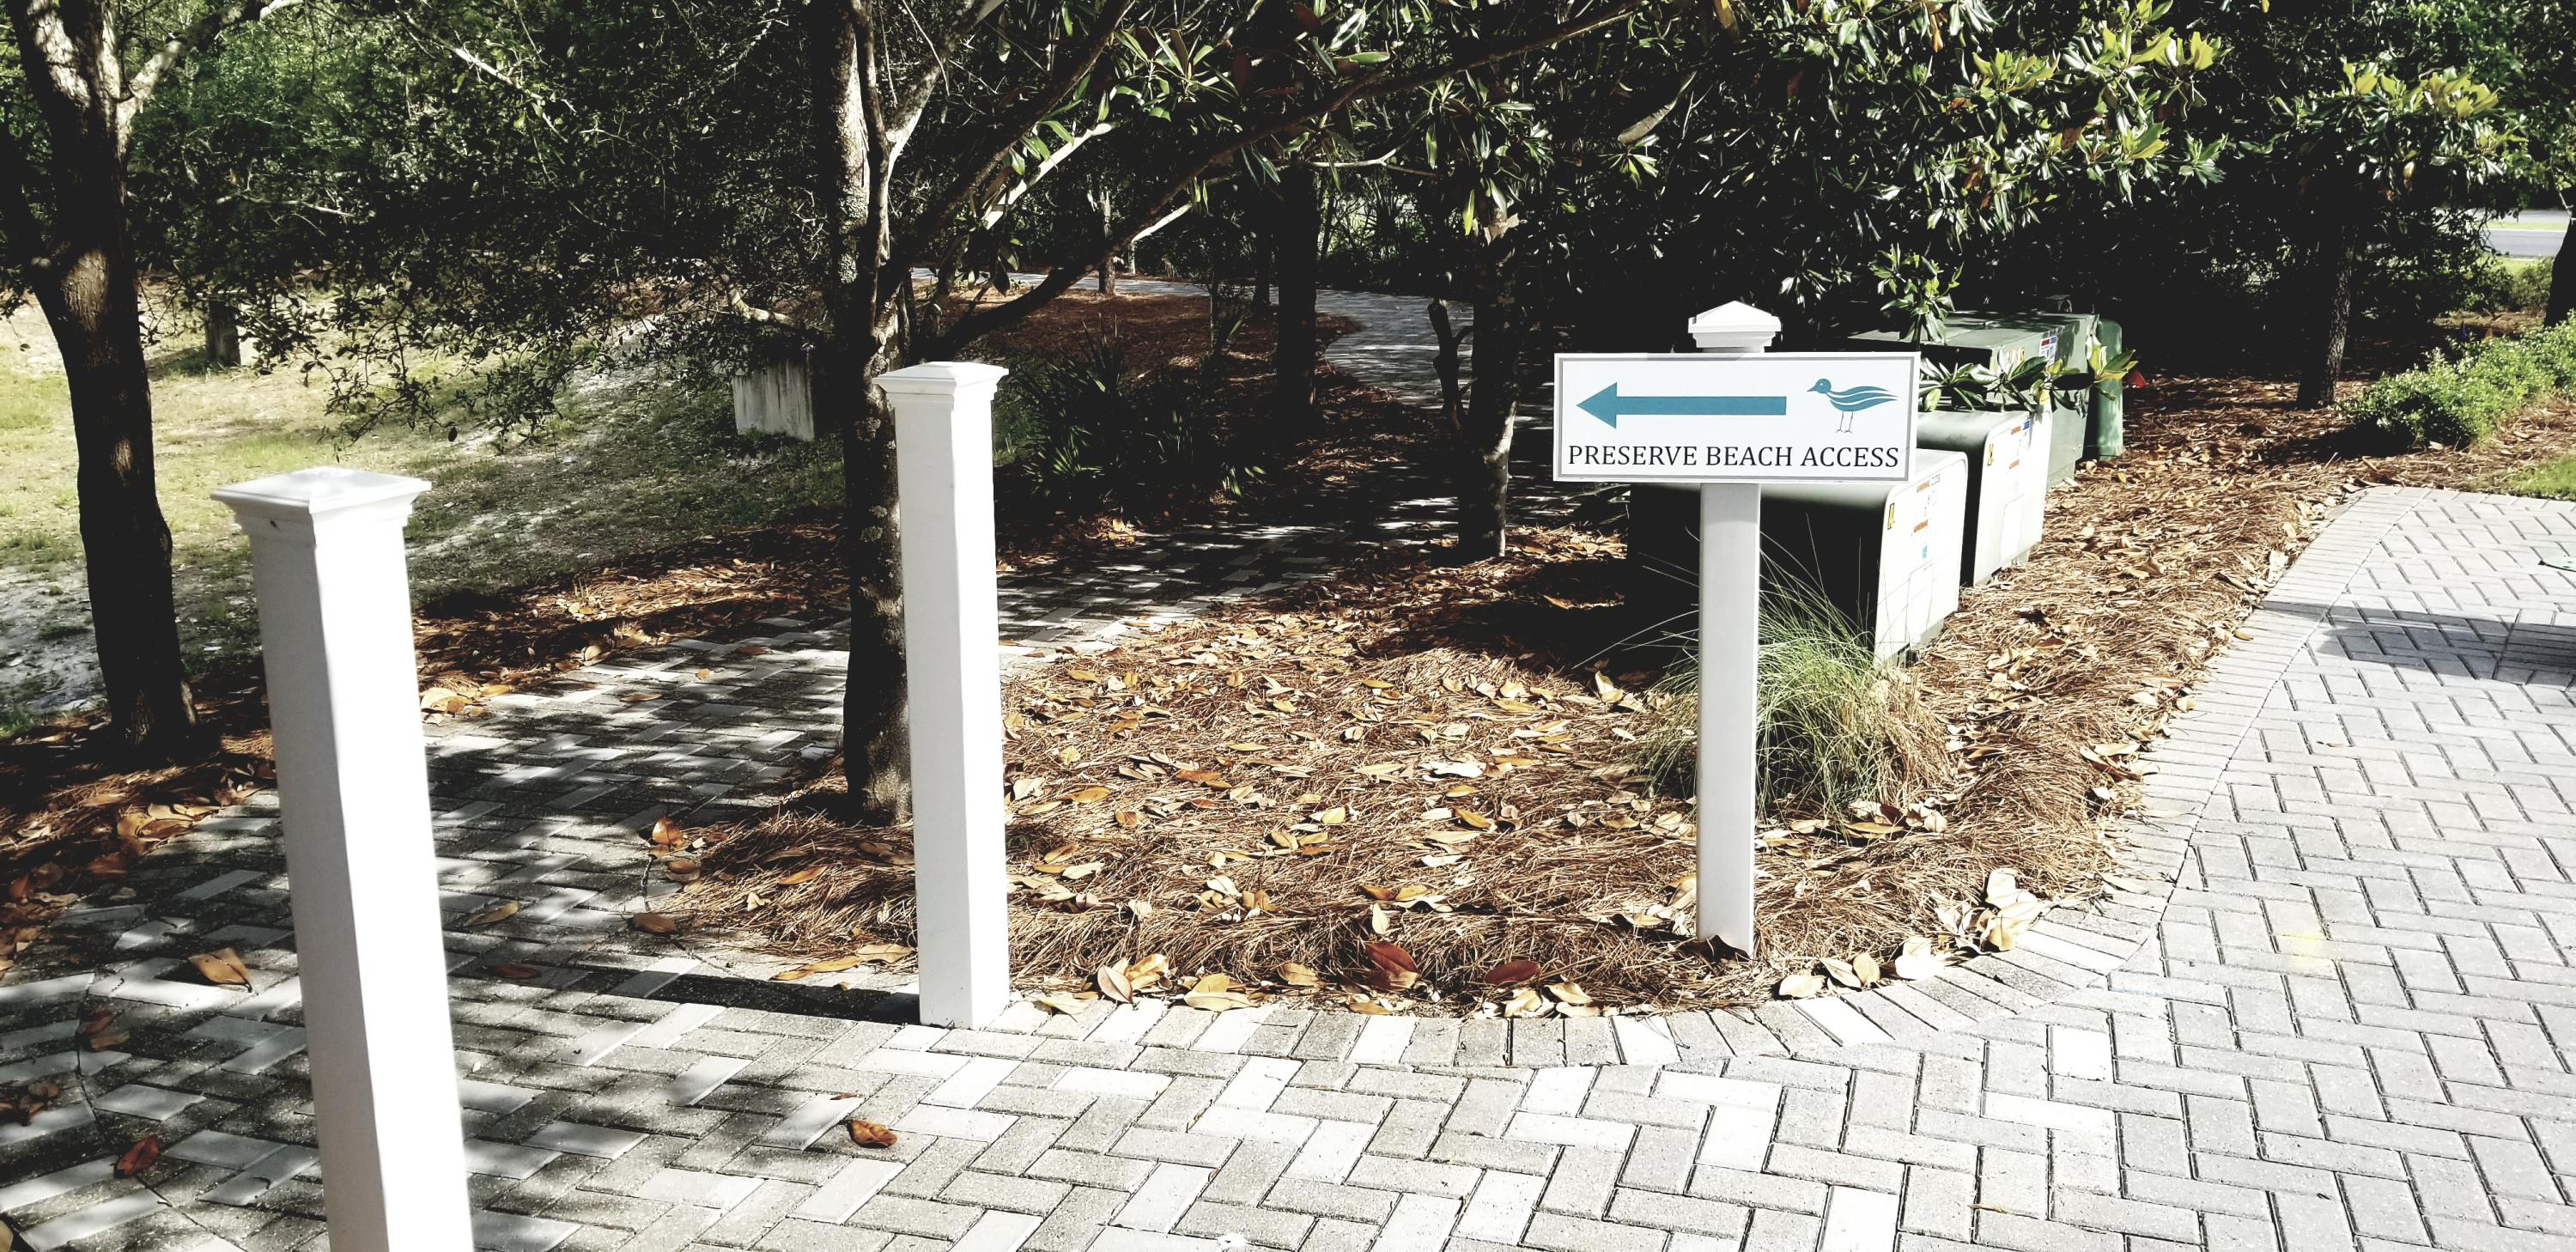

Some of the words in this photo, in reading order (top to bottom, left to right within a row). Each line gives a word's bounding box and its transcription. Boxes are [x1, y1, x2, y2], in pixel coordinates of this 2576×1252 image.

[1568, 445, 1698, 466] PRESERVE
[1706, 446, 1793, 466] BEACH
[1800, 447, 1899, 468] ACCESS
